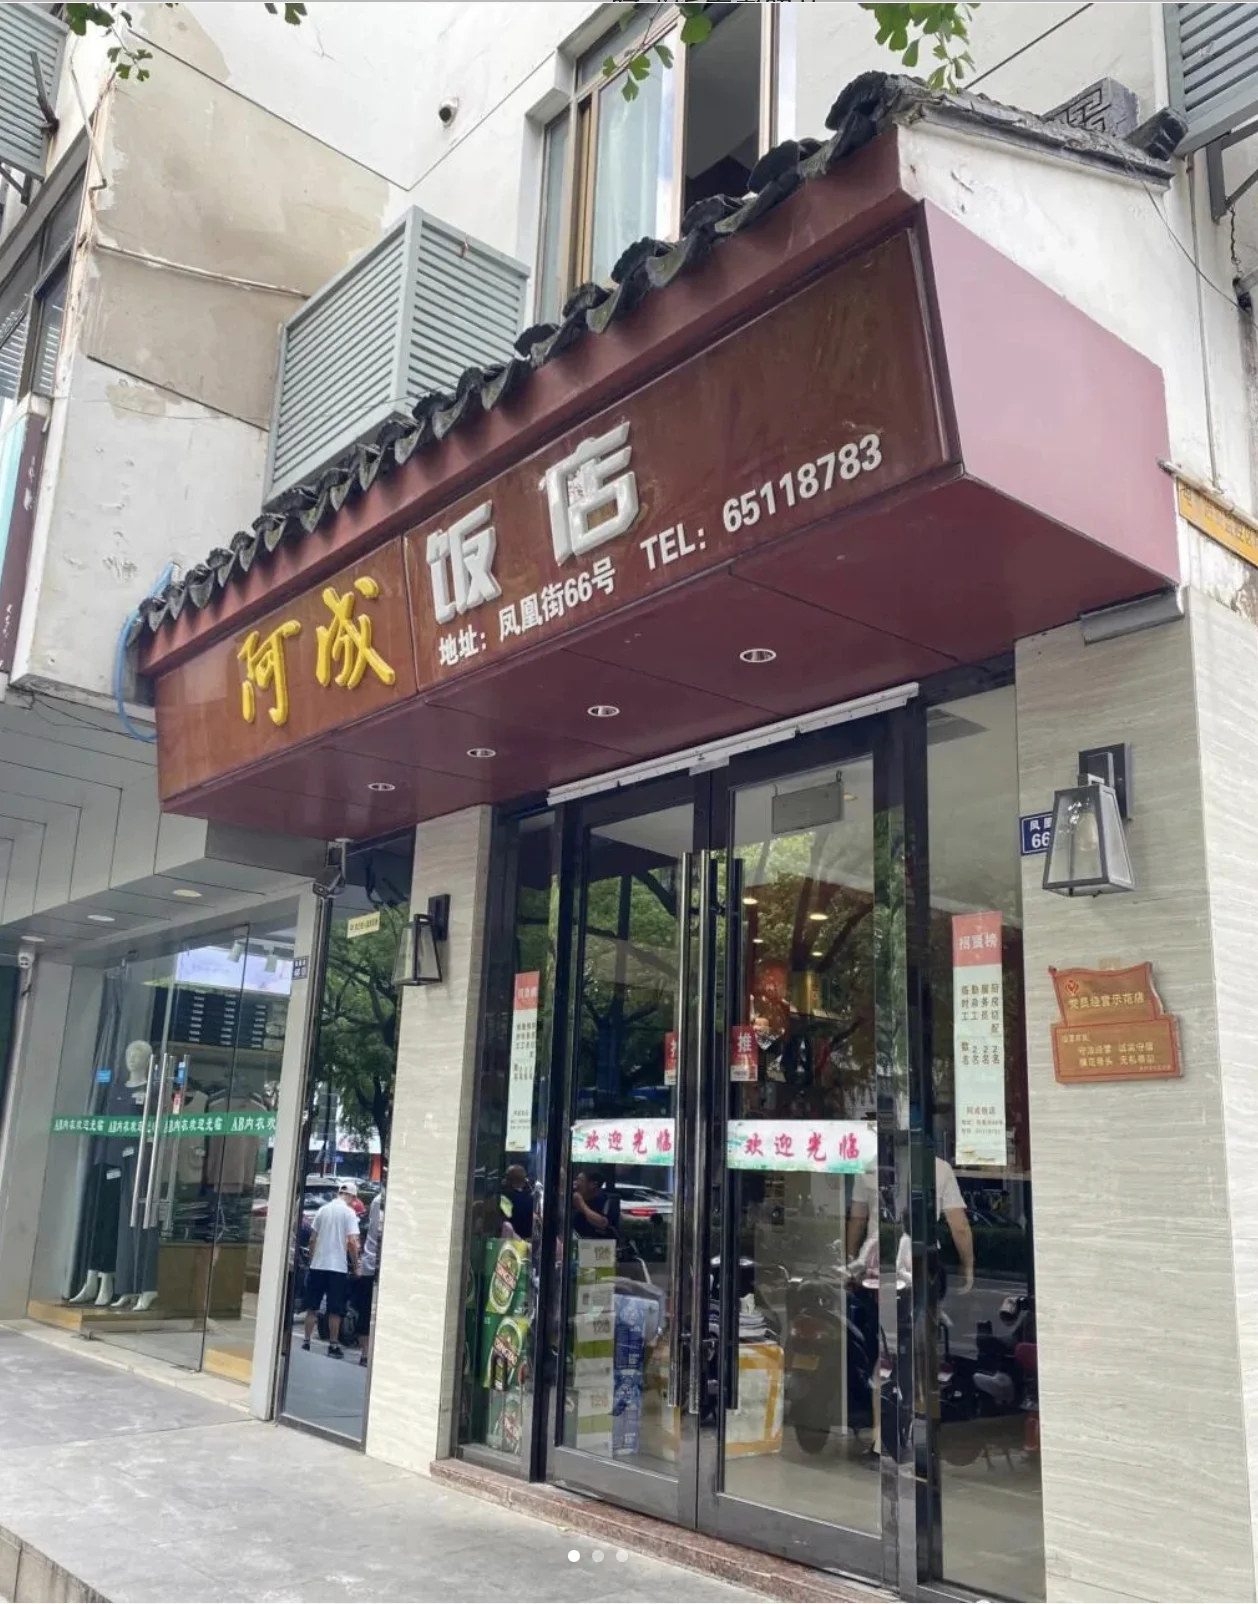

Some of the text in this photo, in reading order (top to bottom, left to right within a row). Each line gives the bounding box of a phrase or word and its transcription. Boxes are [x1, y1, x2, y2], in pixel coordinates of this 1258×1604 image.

[640, 434, 882, 570] TEL: 65118783
[237, 421, 639, 725] 阿成 饭店
[438, 556, 615, 666] 地址： 凤凰街66号
[737, 1032, 752, 1052] 推
[584, 1128, 672, 1155] 欢迎光临
[744, 1132, 861, 1162] 欢迎光临
